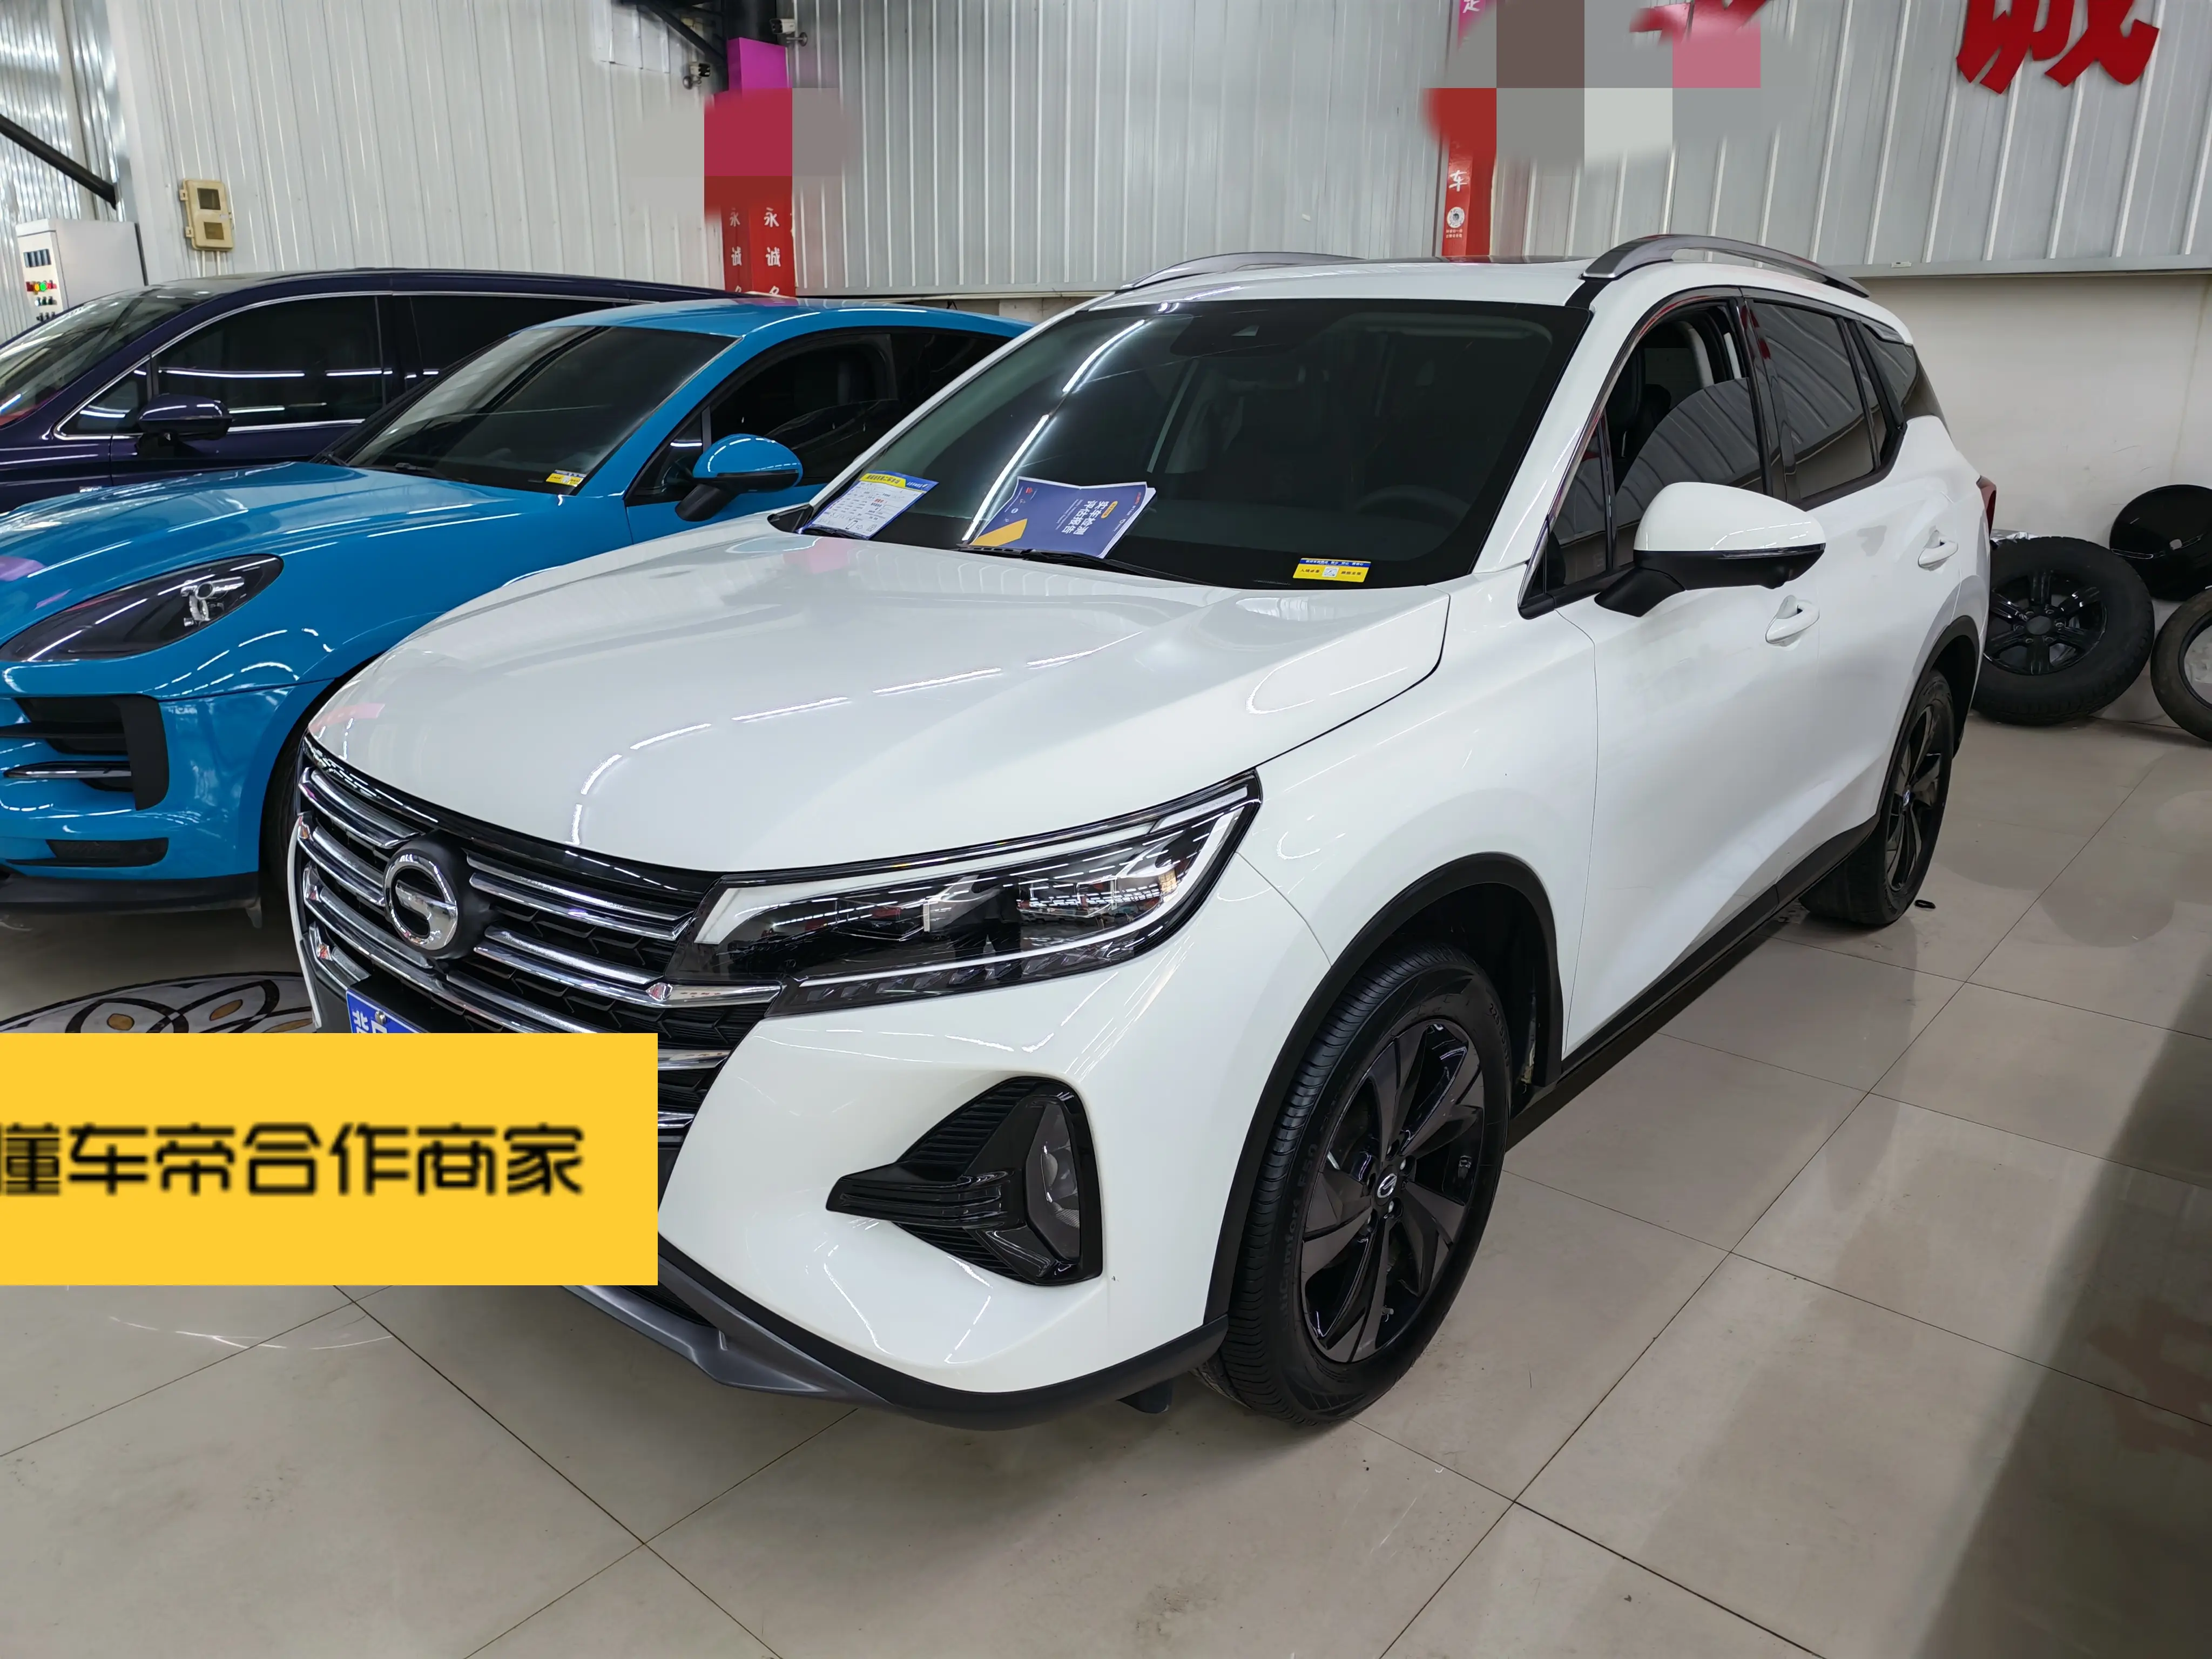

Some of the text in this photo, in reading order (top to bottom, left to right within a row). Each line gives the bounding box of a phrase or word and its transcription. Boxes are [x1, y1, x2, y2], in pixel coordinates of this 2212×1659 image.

[1448, 170, 1468, 192] 车
[1061, 500, 1098, 534] 评估报告
[1073, 501, 1110, 535] 实车检测
